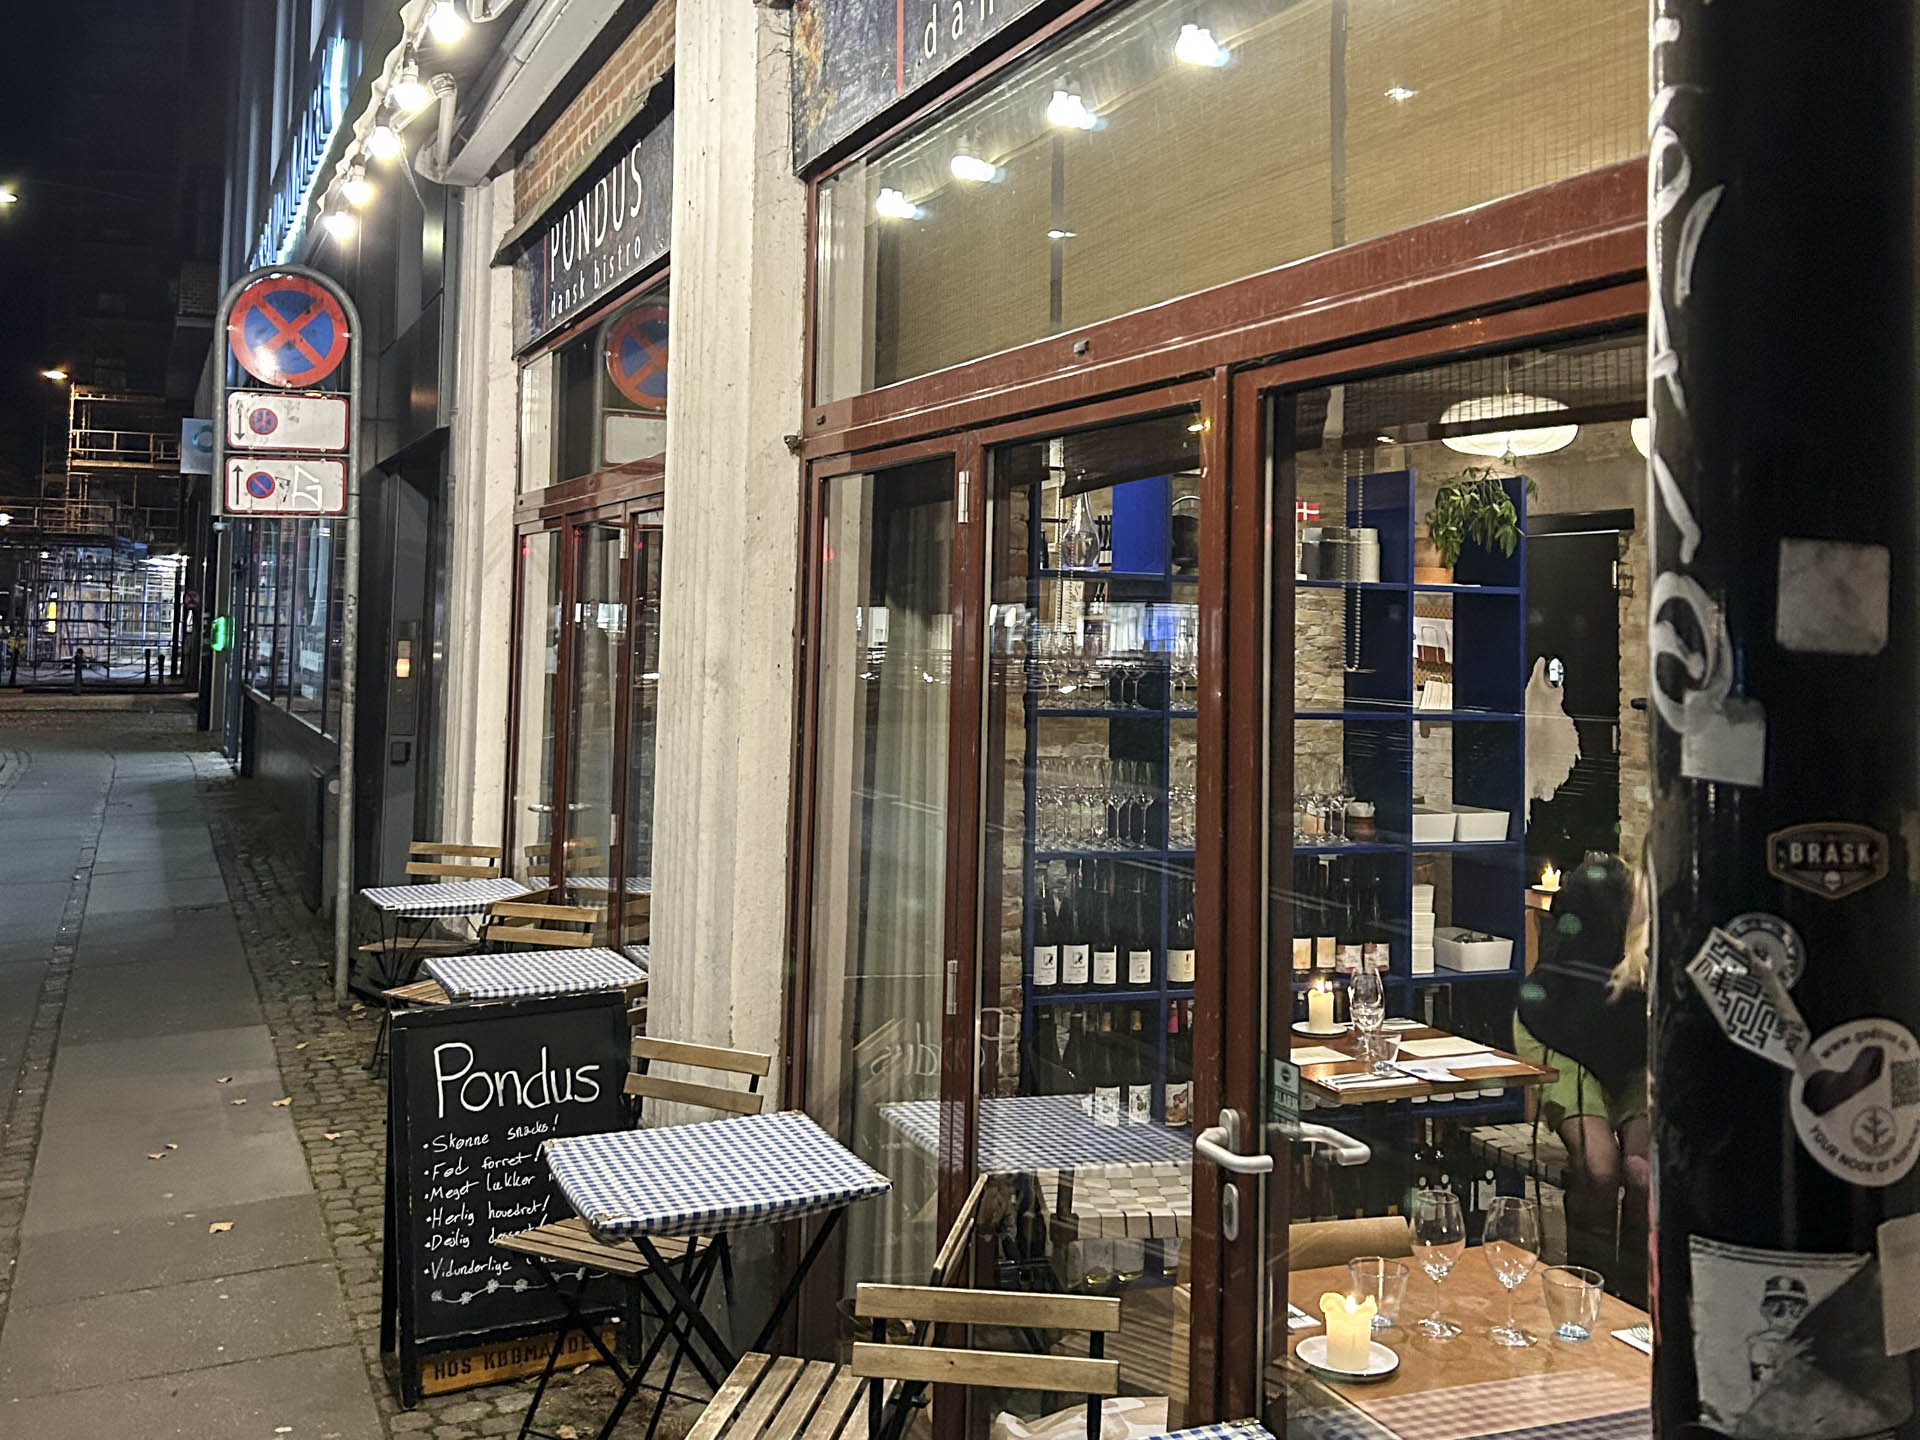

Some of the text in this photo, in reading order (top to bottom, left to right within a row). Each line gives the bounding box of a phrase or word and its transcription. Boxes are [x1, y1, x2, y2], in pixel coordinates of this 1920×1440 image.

[551, 141, 643, 283] PONDUS
[551, 235, 642, 319] dansk bistro
[1789, 842, 1871, 864] BRASK
[433, 1042, 600, 1119] Pondus
[432, 1113, 559, 1153] Skønne snacks!
[429, 1180, 480, 1203] Meget
[432, 1202, 475, 1228] Herlig
[431, 1228, 471, 1251] Dejlig
[431, 1255, 513, 1281] Vidunderlige
[434, 1357, 472, 1381] HOS
